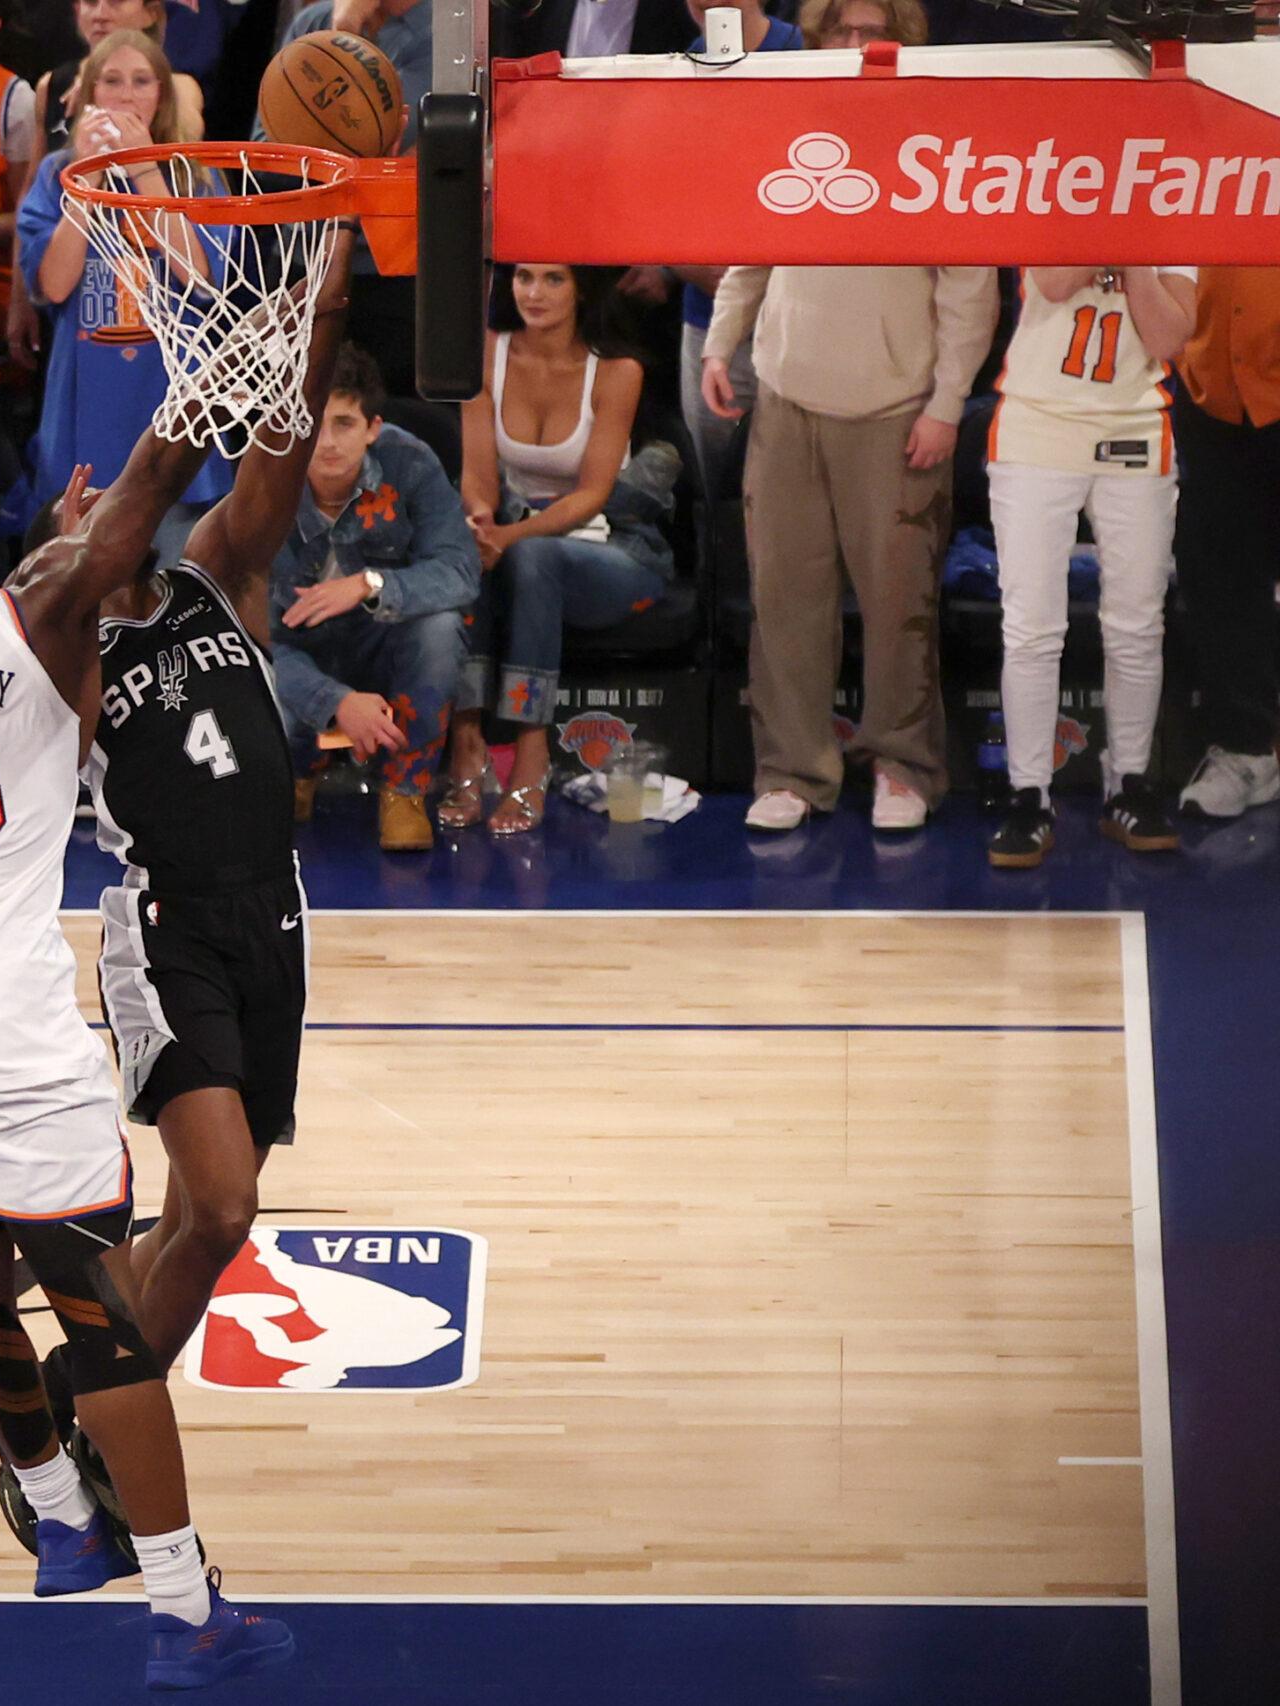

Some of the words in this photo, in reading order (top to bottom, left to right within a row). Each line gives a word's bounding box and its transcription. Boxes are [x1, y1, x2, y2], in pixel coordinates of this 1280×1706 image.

[331, 35, 393, 113] Wilson
[890, 134, 1105, 214] State
[1061, 304, 1123, 383] 11
[100, 631, 250, 730] SPURS
[183, 708, 240, 779] 4
[312, 1237, 441, 1264] NBA
